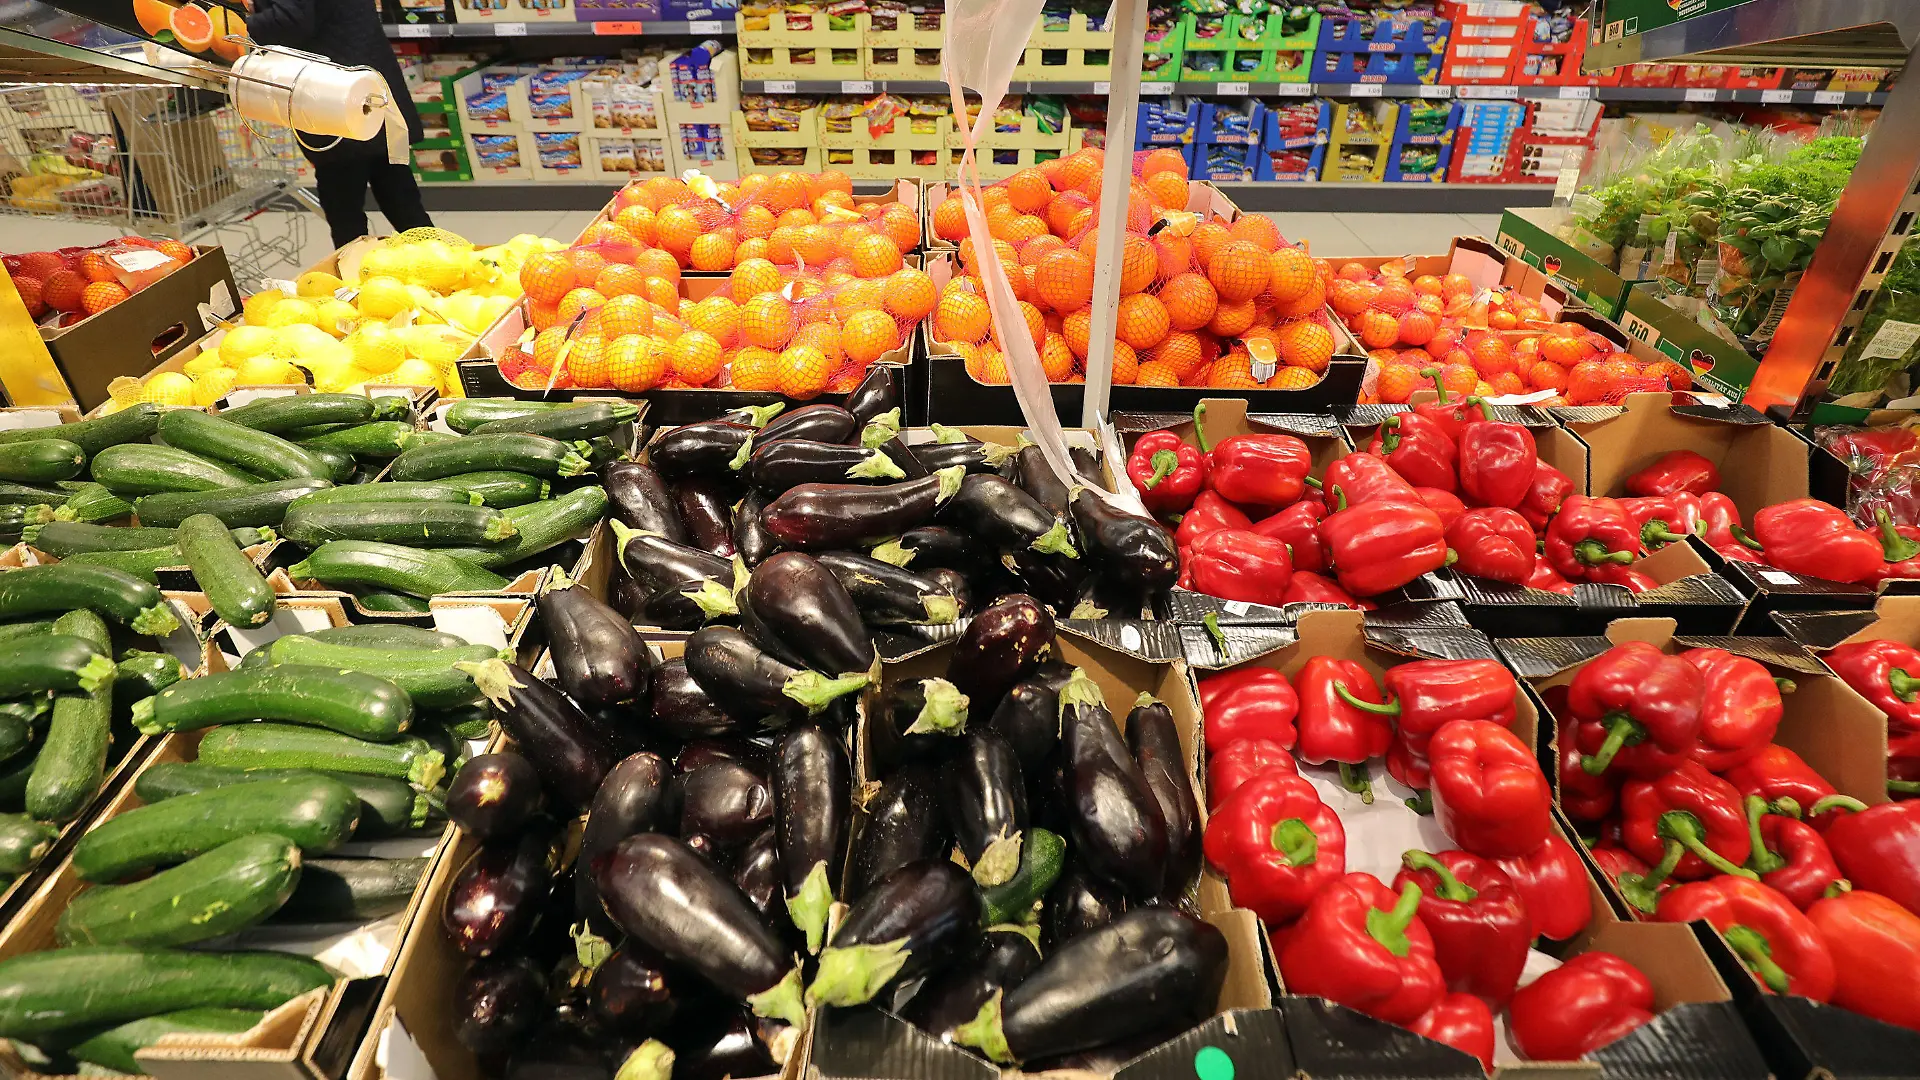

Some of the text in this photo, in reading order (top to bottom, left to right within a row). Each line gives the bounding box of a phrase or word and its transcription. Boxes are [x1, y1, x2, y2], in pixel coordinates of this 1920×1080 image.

[1368, 43, 1396, 52] HARIBO
[1360, 75, 1387, 83] HARIBO
[1151, 134, 1177, 142] HARIBO
[1411, 135, 1436, 143] HARIBO
[1285, 137, 1310, 148] HARIBO
[1211, 173, 1236, 181] HARIBO
[1402, 173, 1427, 181] HARIBO
[1726, 389, 1739, 400] AUS
